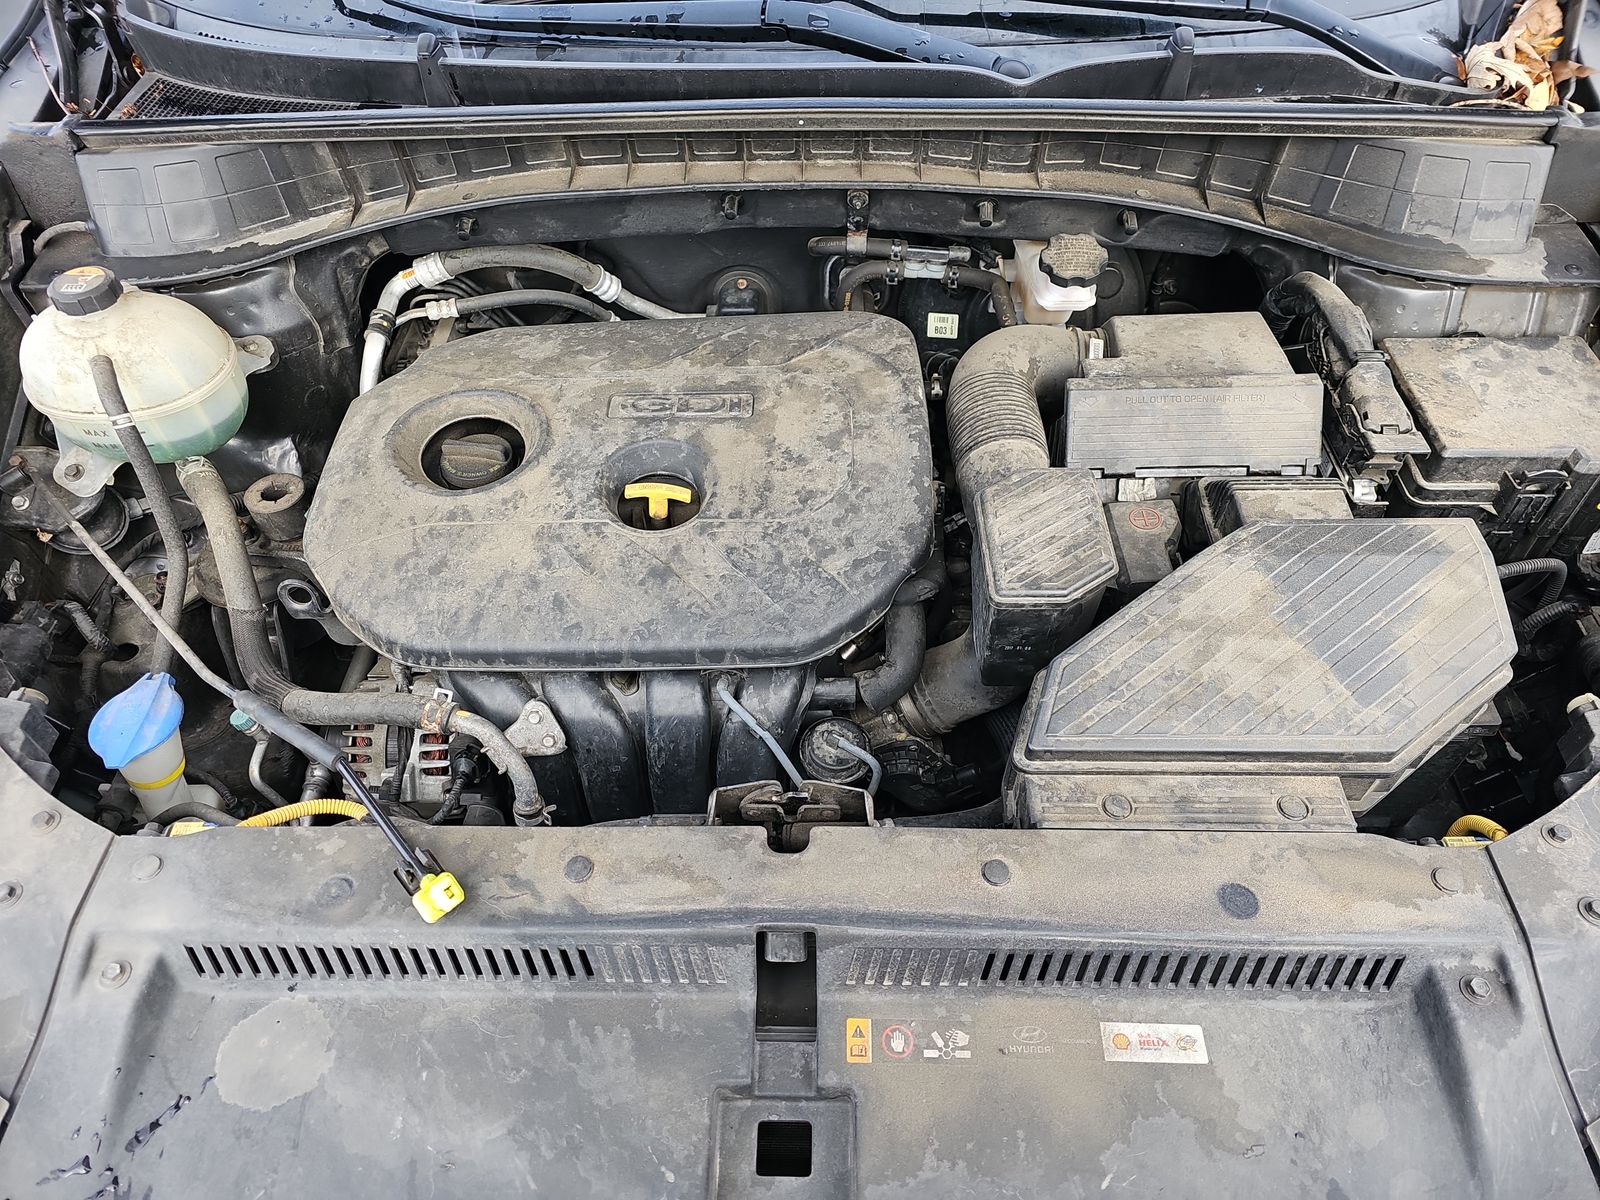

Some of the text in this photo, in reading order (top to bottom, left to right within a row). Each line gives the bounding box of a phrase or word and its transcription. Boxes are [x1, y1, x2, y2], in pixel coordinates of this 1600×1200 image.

[934, 326, 948, 335] B03
[1125, 396, 1149, 404] PULL
[1150, 395, 1168, 404] OUT
[1171, 395, 1182, 403] TO
[1184, 395, 1209, 403] OPEN
[1213, 394, 1231, 403] (AIR
[620, 396, 742, 413] GDI
[83, 428, 109, 437] MAX
[92, 441, 119, 449] MIN
[1138, 1039, 1170, 1048] HELIX
[1009, 1045, 1054, 1054] HYUNDAI
